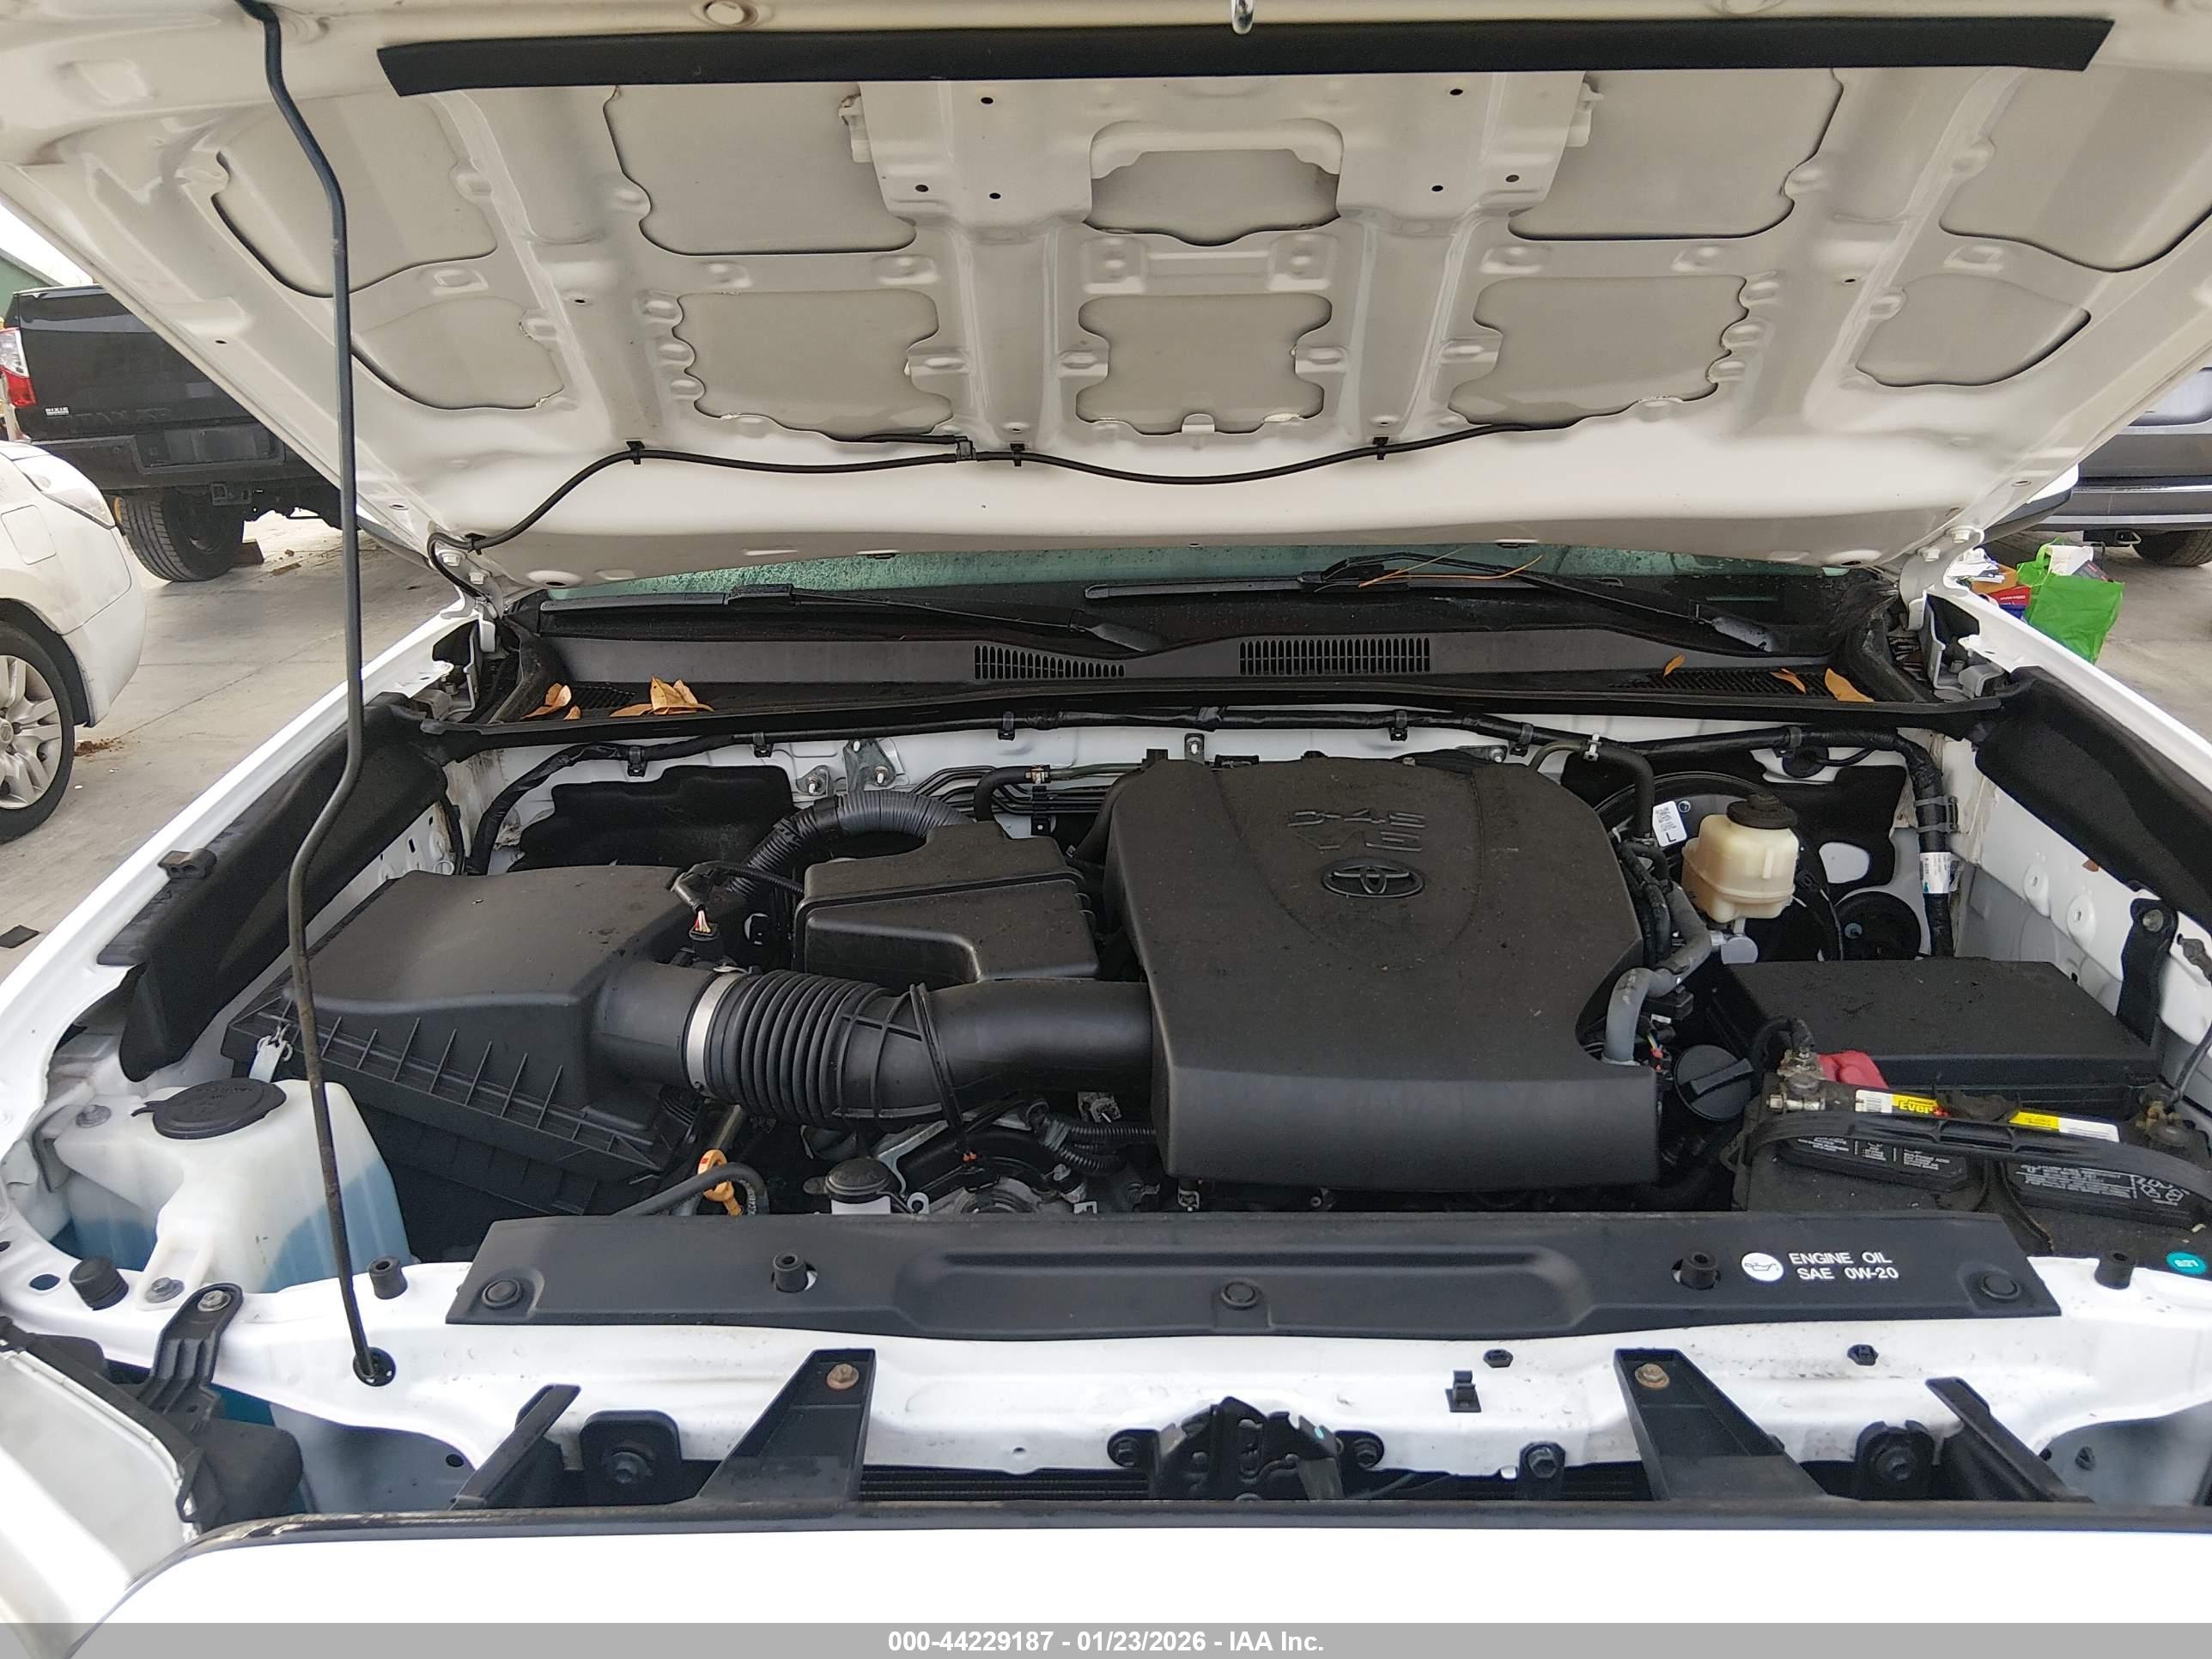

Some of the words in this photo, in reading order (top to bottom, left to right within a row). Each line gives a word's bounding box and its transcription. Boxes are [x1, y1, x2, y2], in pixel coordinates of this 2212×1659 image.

[1666, 831, 1677, 843] L
[1788, 1252, 1855, 1266] ENGINE
[1862, 1251, 1893, 1264] OIL
[1796, 1267, 1835, 1280] SAE
[1844, 1267, 1899, 1281] 0W-20
